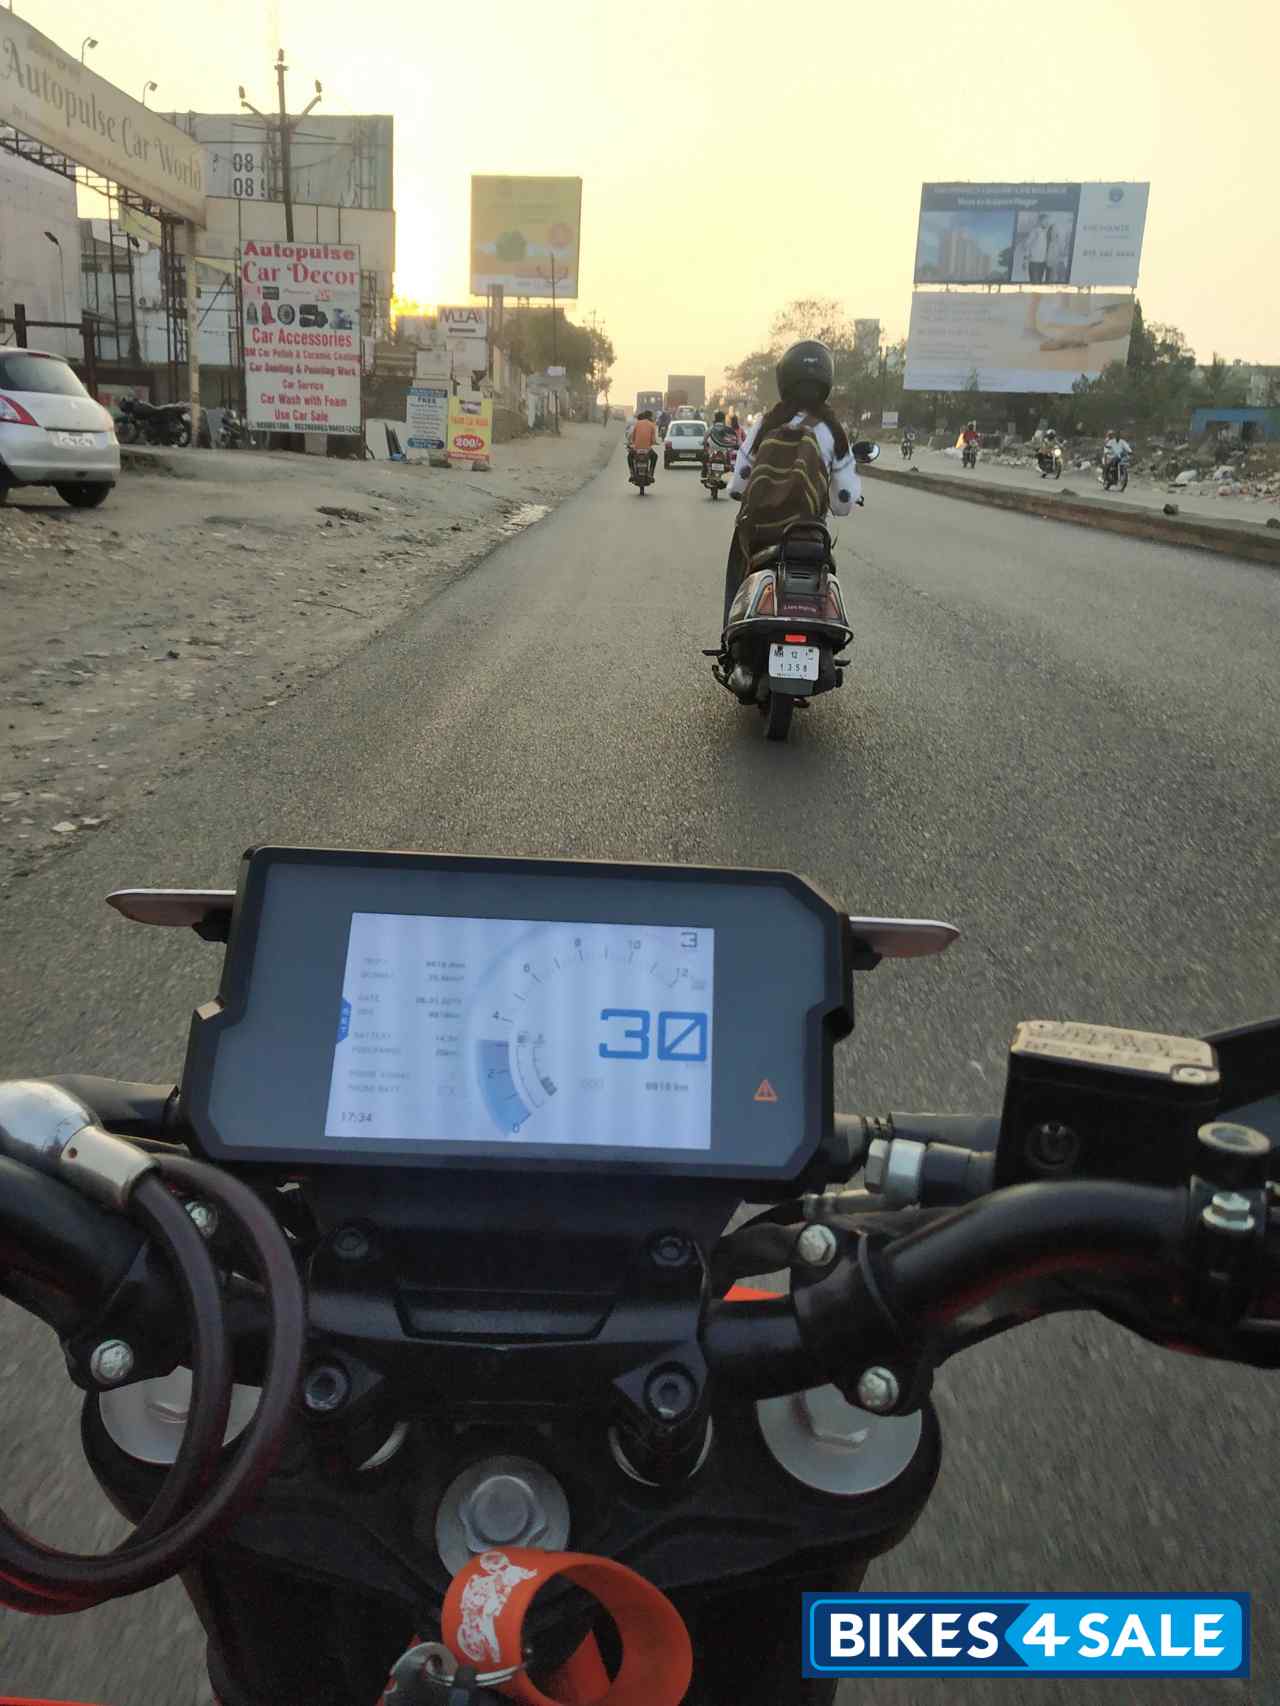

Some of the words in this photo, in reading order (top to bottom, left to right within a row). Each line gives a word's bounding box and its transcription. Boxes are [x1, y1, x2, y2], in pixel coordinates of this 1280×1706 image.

[2, 37, 117, 143] Autopulse
[121, 115, 150, 160] Car
[154, 135, 201, 191] World
[243, 241, 354, 262] Autopulse
[243, 260, 281, 284] Car
[286, 262, 359, 285] Decor
[252, 327, 273, 344] Car
[278, 328, 353, 347] Accessories
[249, 362, 263, 372] Car
[282, 379, 294, 390] Car
[298, 380, 324, 391] Service
[261, 393, 275, 404] Car
[279, 394, 301, 405] Wash
[304, 395, 321, 406] with
[325, 396, 348, 407] Foam
[274, 408, 290, 420] Use
[293, 409, 307, 420] Car
[311, 411, 328, 422] Sale
[681, 932, 698, 948] 3
[599, 1008, 709, 1062] 30
[341, 1111, 373, 1123] 17:34
